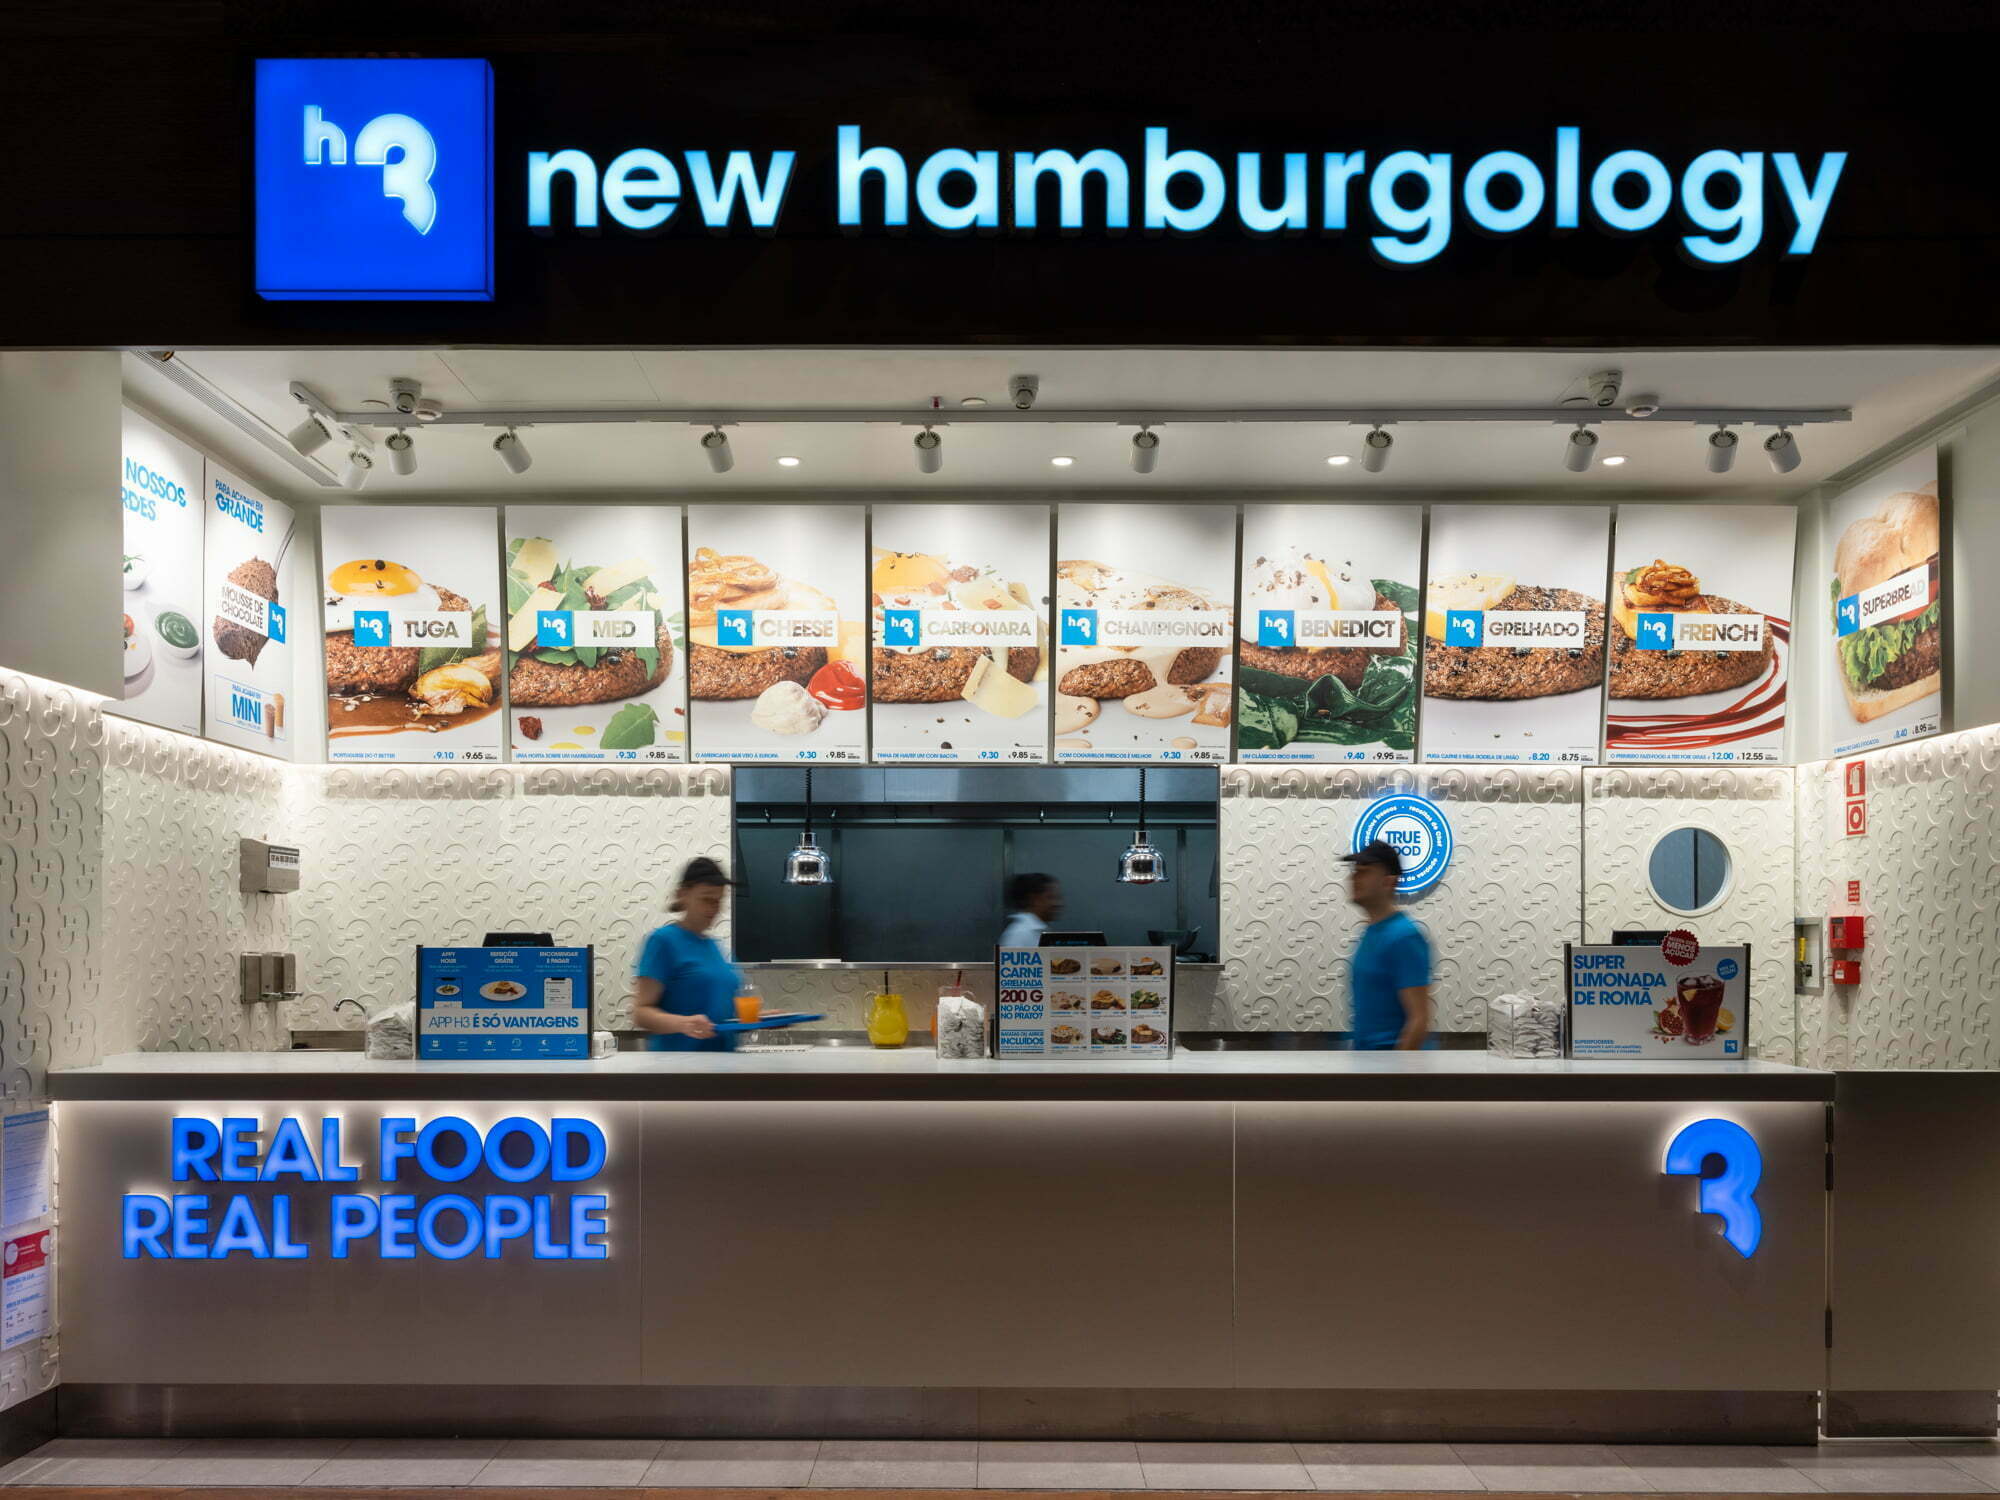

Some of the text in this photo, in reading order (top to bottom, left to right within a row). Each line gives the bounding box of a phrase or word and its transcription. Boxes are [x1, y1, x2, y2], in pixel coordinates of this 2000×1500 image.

[527, 124, 1848, 264] new hamburgology
[126, 456, 187, 508] NOSSOS
[216, 479, 231, 496] PARA
[120, 487, 157, 521] RDES
[215, 492, 264, 533] GRANDE
[222, 586, 264, 615] MOUSSE DE
[1862, 580, 1926, 617] SUPERBREAD
[221, 600, 264, 629] CHOCOLATE
[403, 620, 460, 639] TUGA
[592, 620, 636, 638] MED
[759, 619, 834, 638] CHEESE
[927, 620, 1032, 637] CARBONARA
[1104, 620, 1224, 637] CHAMPIGNON
[1300, 619, 1396, 638] BENEDICT
[1488, 621, 1580, 637] GRELHADO
[1679, 622, 1759, 642] FRENCH
[232, 693, 262, 725] MINI
[1385, 830, 1421, 844] TRUE
[1390, 845, 1421, 857] OOD
[1667, 940, 1696, 953] MENOS
[1000, 951, 1042, 965] PURA
[1573, 955, 1625, 969] SUPER
[1000, 967, 1043, 978] CARNE
[1574, 972, 1667, 987] LIMONADA
[1000, 979, 1043, 987] GRELHADA
[1000, 990, 1044, 1003] 200 G
[1574, 987, 1652, 1005] DE ROMÃ
[428, 1012, 579, 1028] APP H3 É SÓ VANTAGENS
[172, 1116, 607, 1183] REAL FOOD
[122, 1194, 309, 1260] REAL
[331, 1193, 607, 1260] PEOPLE
